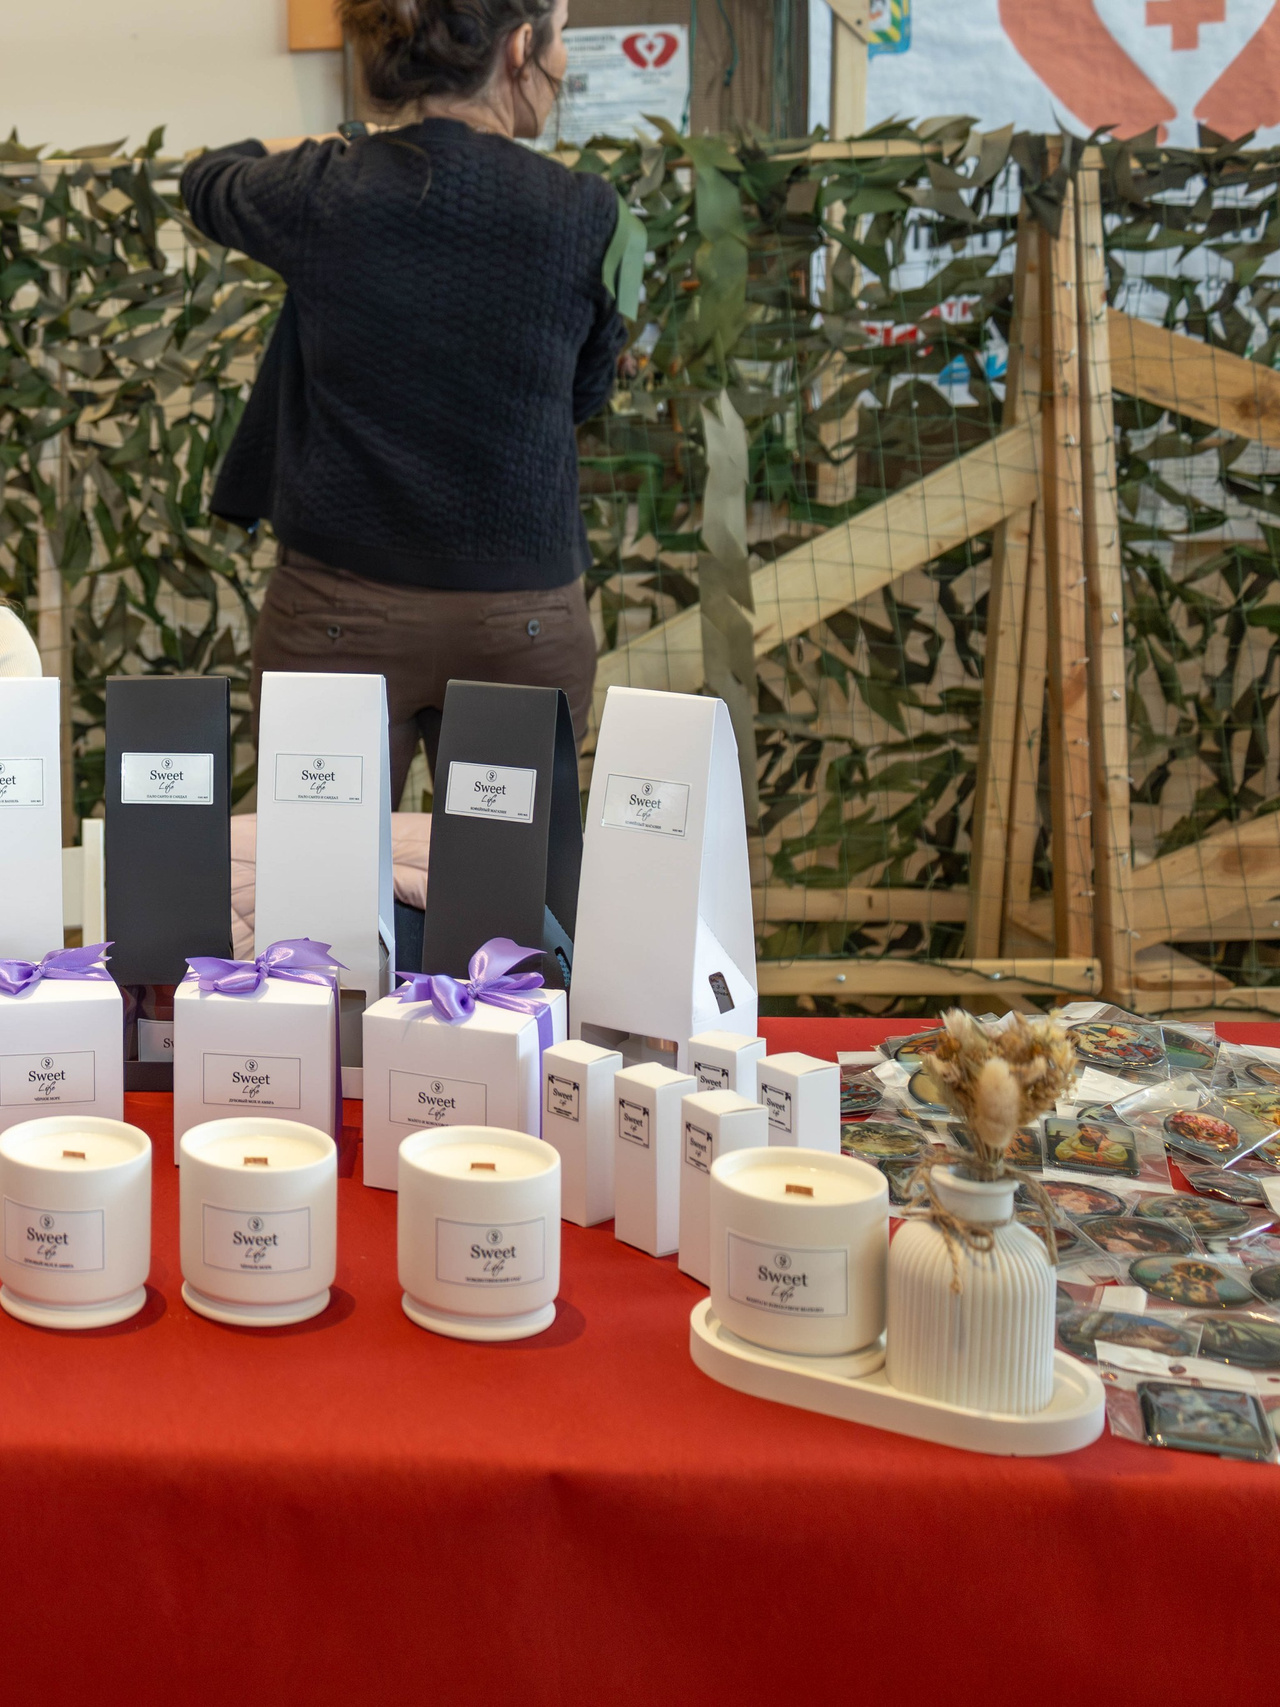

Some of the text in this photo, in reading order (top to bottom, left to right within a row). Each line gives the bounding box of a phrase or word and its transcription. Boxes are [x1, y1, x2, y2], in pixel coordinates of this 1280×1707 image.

[150, 770, 184, 781] Sweet
[301, 770, 336, 781] Sweet
[474, 781, 506, 795] Sweet
[629, 793, 662, 809] Sweet
[28, 1070, 66, 1082] Sweet
[232, 1071, 271, 1085] Sweet
[700, 1075, 722, 1088] Sweet
[417, 1091, 456, 1109] Sweet
[26, 1226, 69, 1245] Sweet
[233, 1230, 278, 1246] Sweet
[470, 1244, 517, 1259] Sweet
[758, 1265, 808, 1287] Sweet
